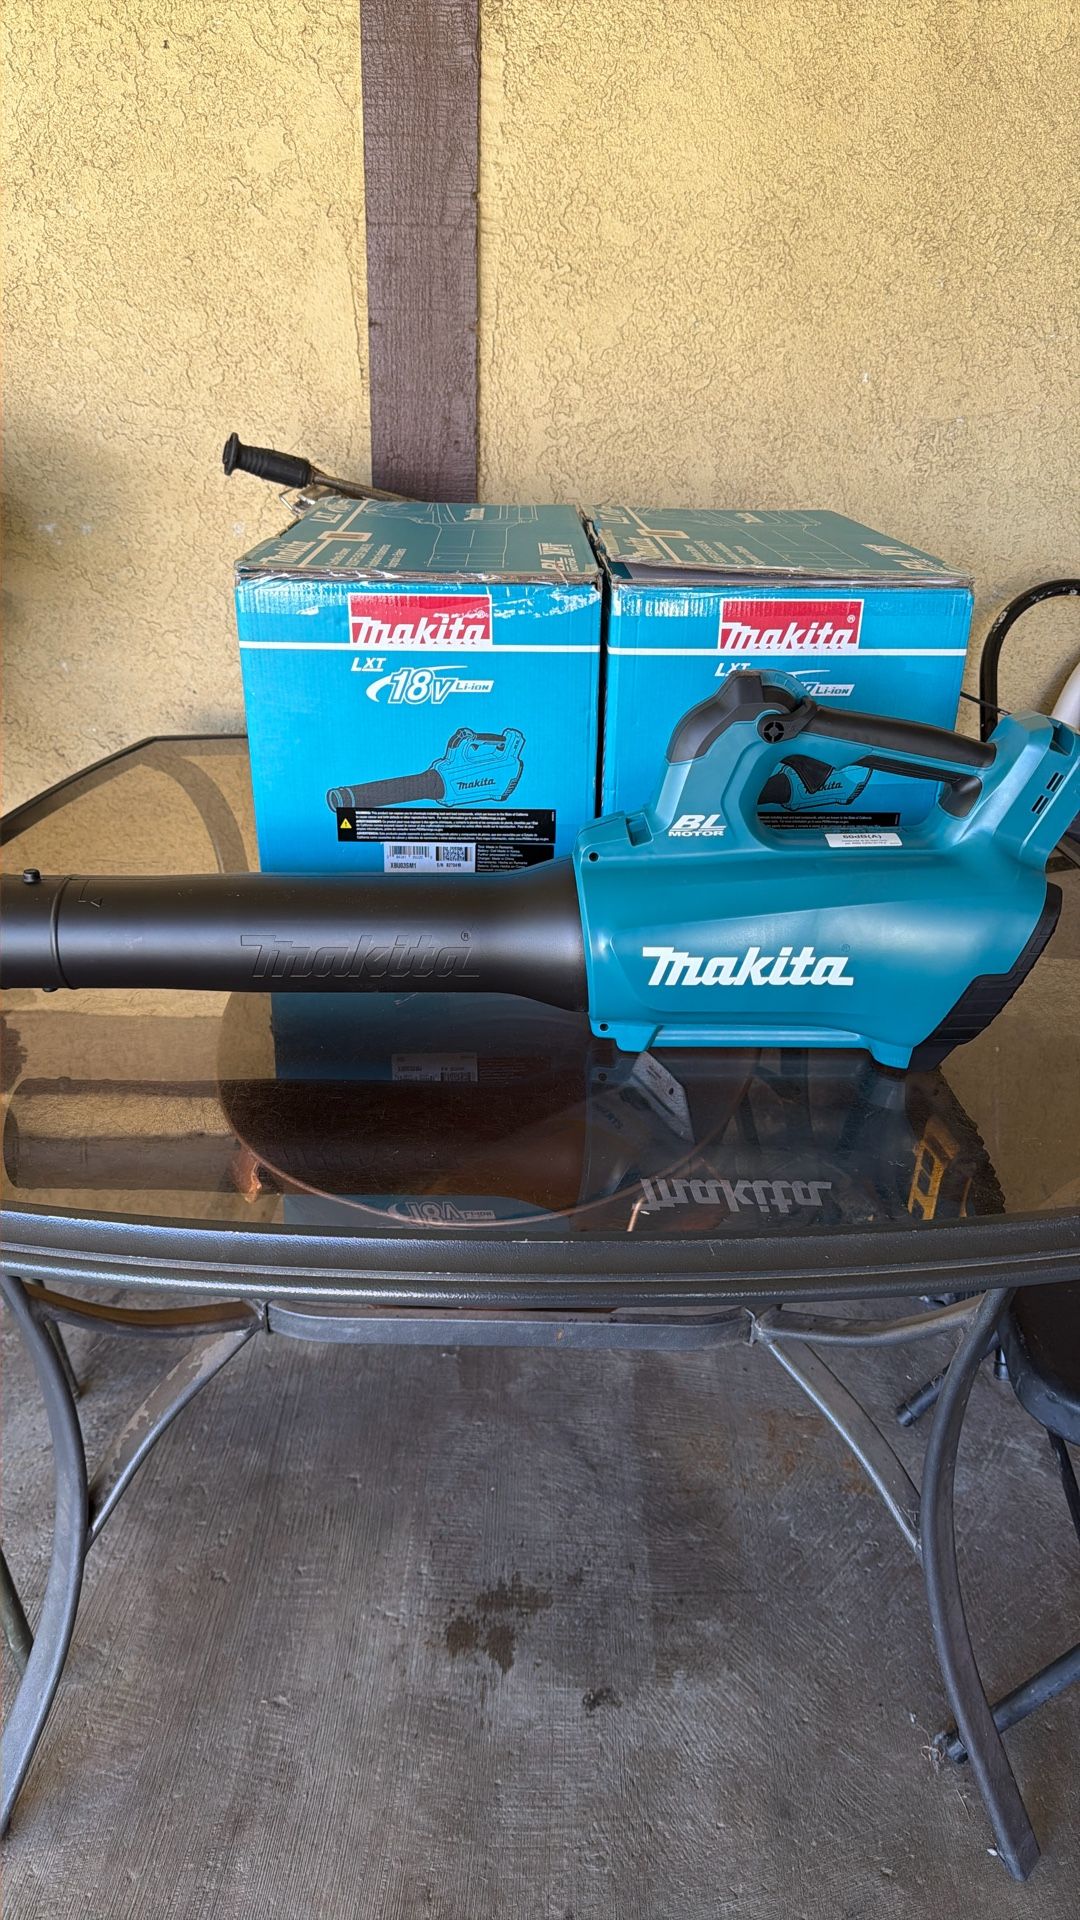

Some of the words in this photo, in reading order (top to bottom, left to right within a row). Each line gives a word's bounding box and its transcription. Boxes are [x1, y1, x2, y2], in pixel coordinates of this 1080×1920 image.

[351, 614, 491, 645] Makita
[721, 621, 858, 650] Makita
[351, 657, 387, 672] LXT
[388, 667, 460, 705] 18V
[455, 682, 490, 691] Li-ion
[815, 686, 850, 695] Li-ion
[456, 777, 496, 790] Makita
[671, 814, 727, 830] BL
[240, 935, 480, 978] Makita
[642, 946, 854, 986] Makita
